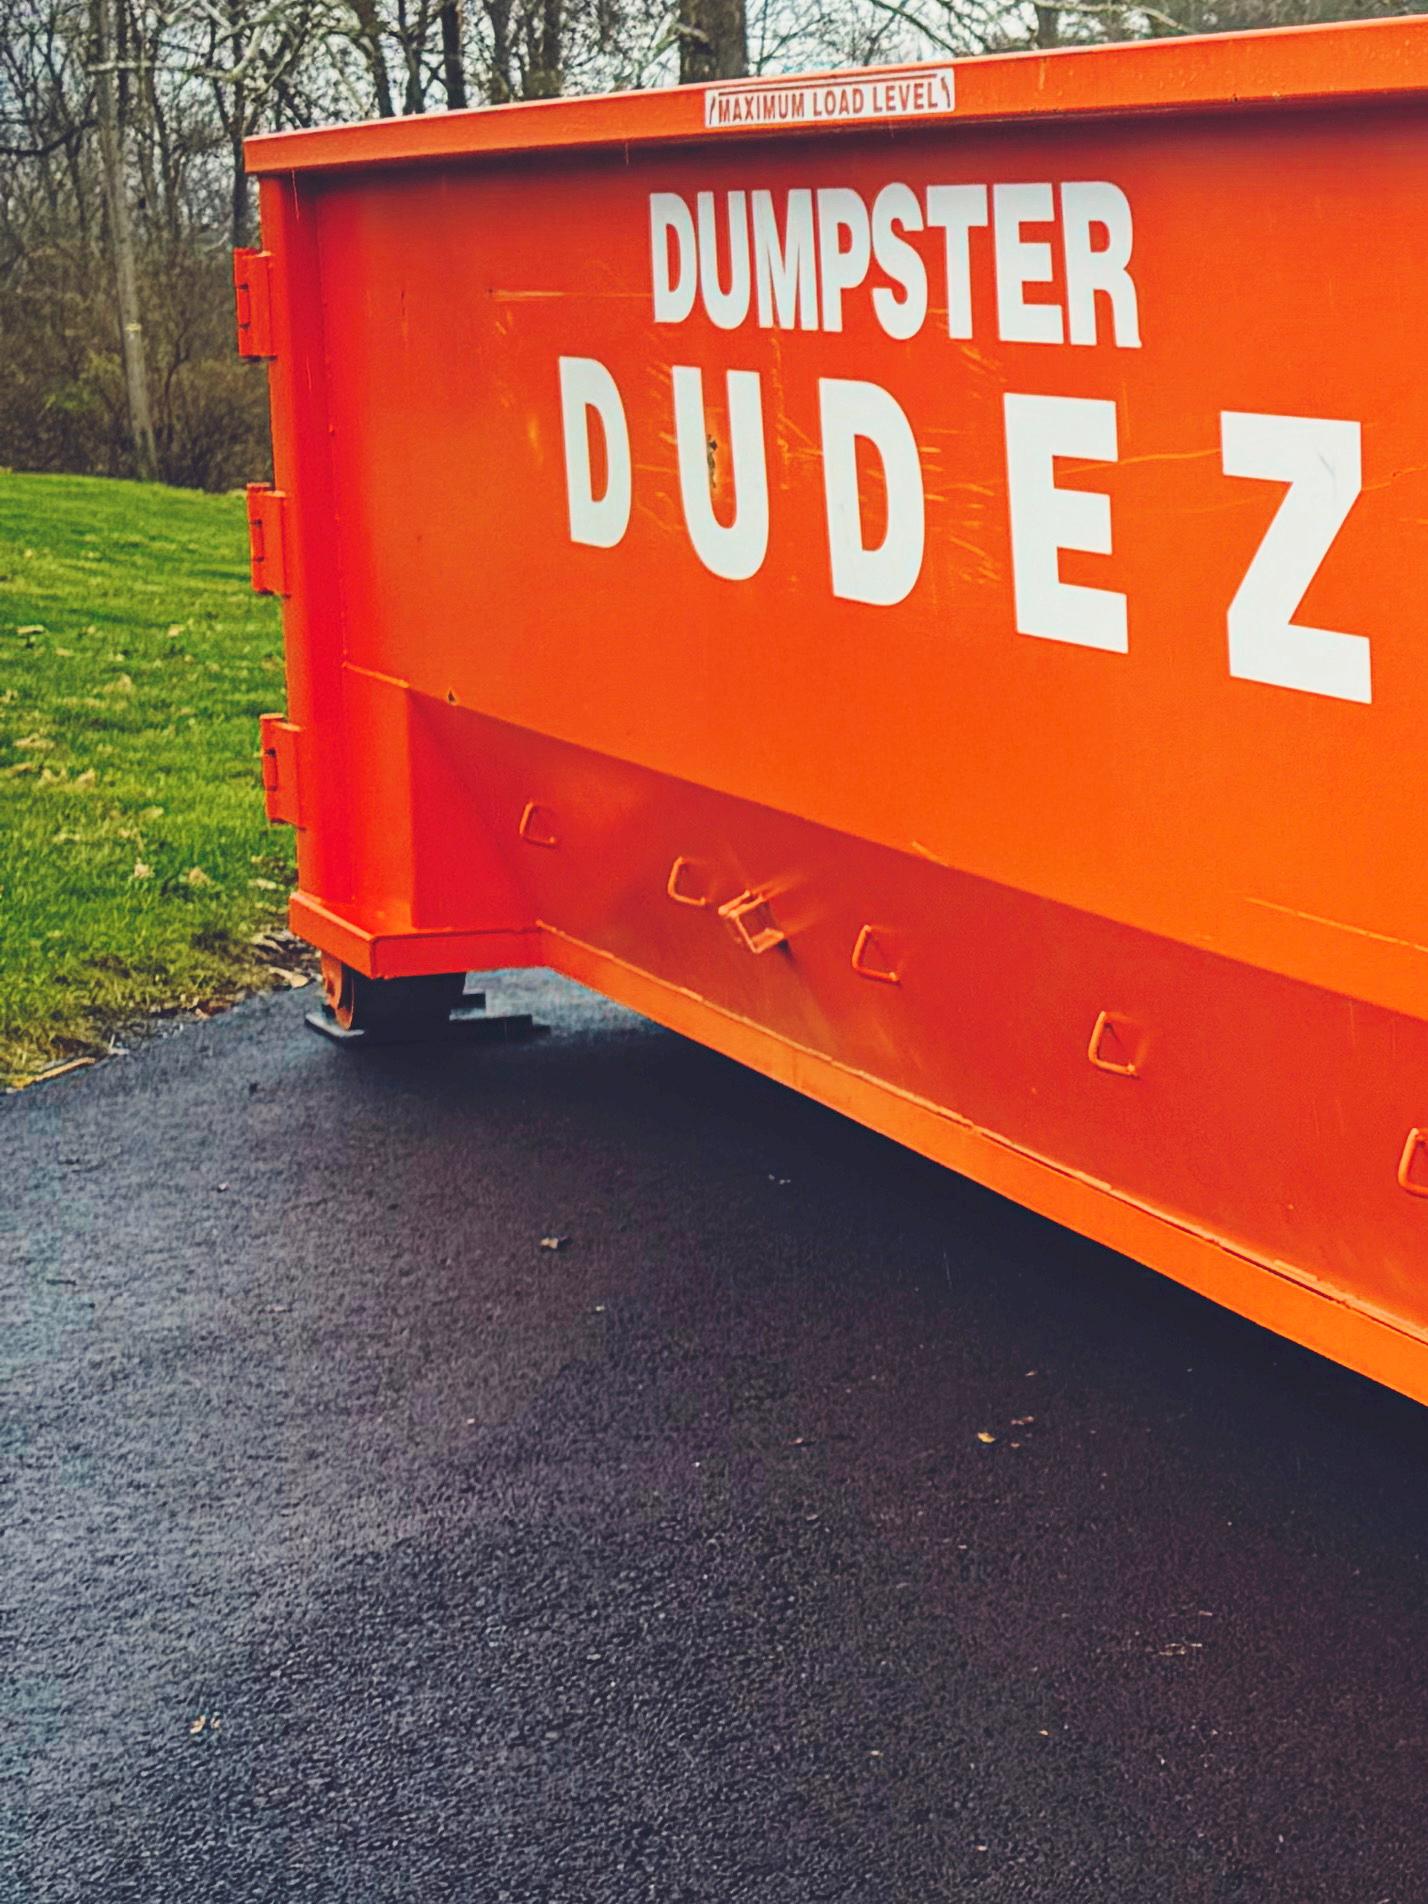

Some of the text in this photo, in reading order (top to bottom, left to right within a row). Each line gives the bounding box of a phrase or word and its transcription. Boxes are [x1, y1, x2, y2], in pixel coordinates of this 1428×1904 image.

[717, 81, 938, 124] MAXIMUM LOAD LEVEL
[649, 180, 1143, 349] DUMPSTER
[558, 356, 1373, 704] DUDEZ
